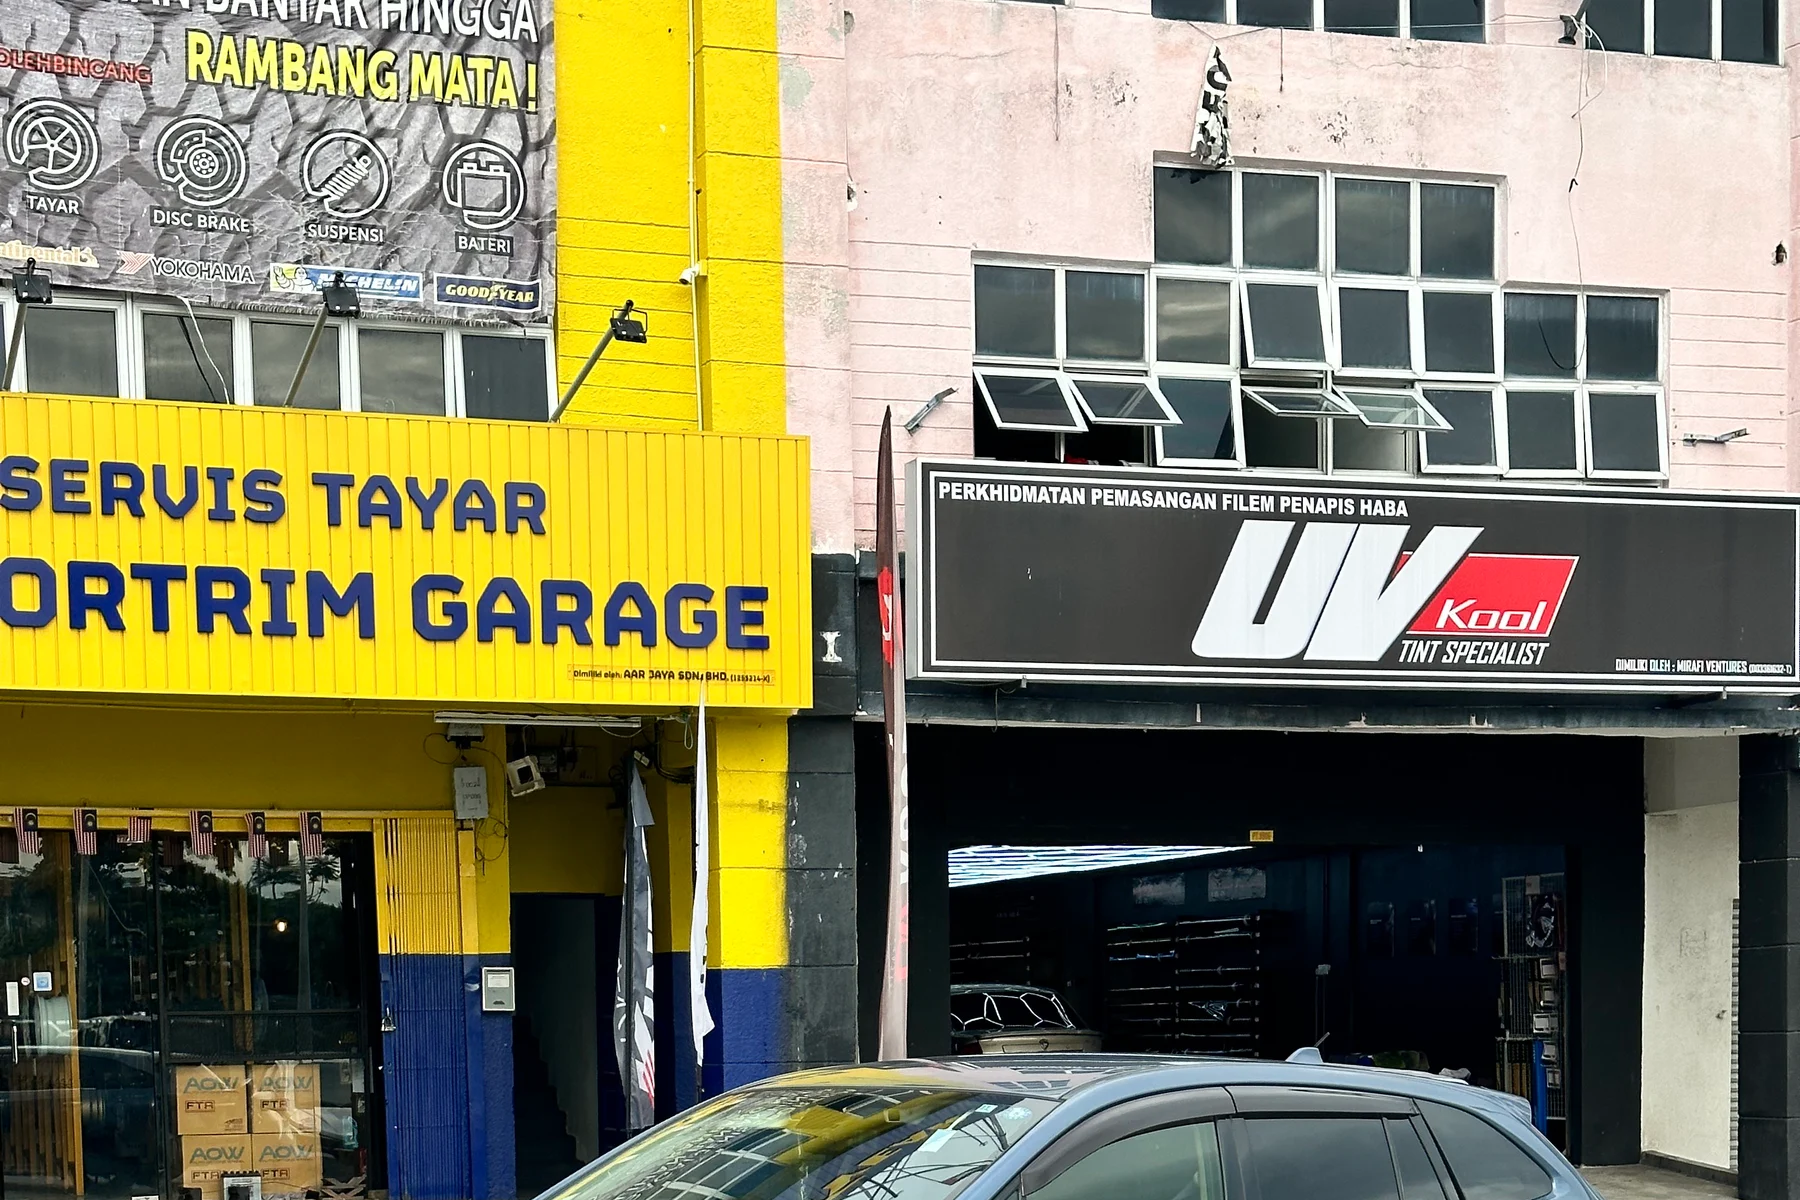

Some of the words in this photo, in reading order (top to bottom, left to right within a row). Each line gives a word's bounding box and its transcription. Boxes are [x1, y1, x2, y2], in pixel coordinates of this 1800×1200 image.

[186, 30, 400, 101] RAMBANG
[26, 195, 80, 215] TAYAR
[153, 209, 193, 227] DISC
[197, 213, 250, 233] BRAKE
[307, 224, 384, 243] SUSPENSI
[458, 237, 511, 253] BATERI
[152, 258, 254, 283] YOKOHAMA
[0, 456, 286, 523] SERVIS
[312, 471, 547, 535] TAYAR
[939, 482, 1086, 505] PERKHIDMATAN
[1090, 488, 1217, 510] PEMASANGAN
[1222, 492, 1276, 512] FILEM
[1279, 496, 1354, 515] PENAPIS
[1360, 499, 1409, 517] HABA
[1191, 519, 1485, 662] UV
[0, 556, 376, 639] ORTRIM
[412, 574, 770, 650] GARAGE
[1435, 598, 1548, 632] Kool
[1399, 639, 1443, 663] TINT
[1441, 640, 1550, 666] SPECIALIST
[623, 669, 646, 679] AAR
[648, 670, 675, 680] JAYA
[1615, 658, 1648, 671] DIMILIKI
[1706, 660, 1747, 674] VENTURES
[184, 1077, 238, 1093] AOW
[190, 1147, 245, 1162] AOW
[260, 1145, 313, 1161] AOW
